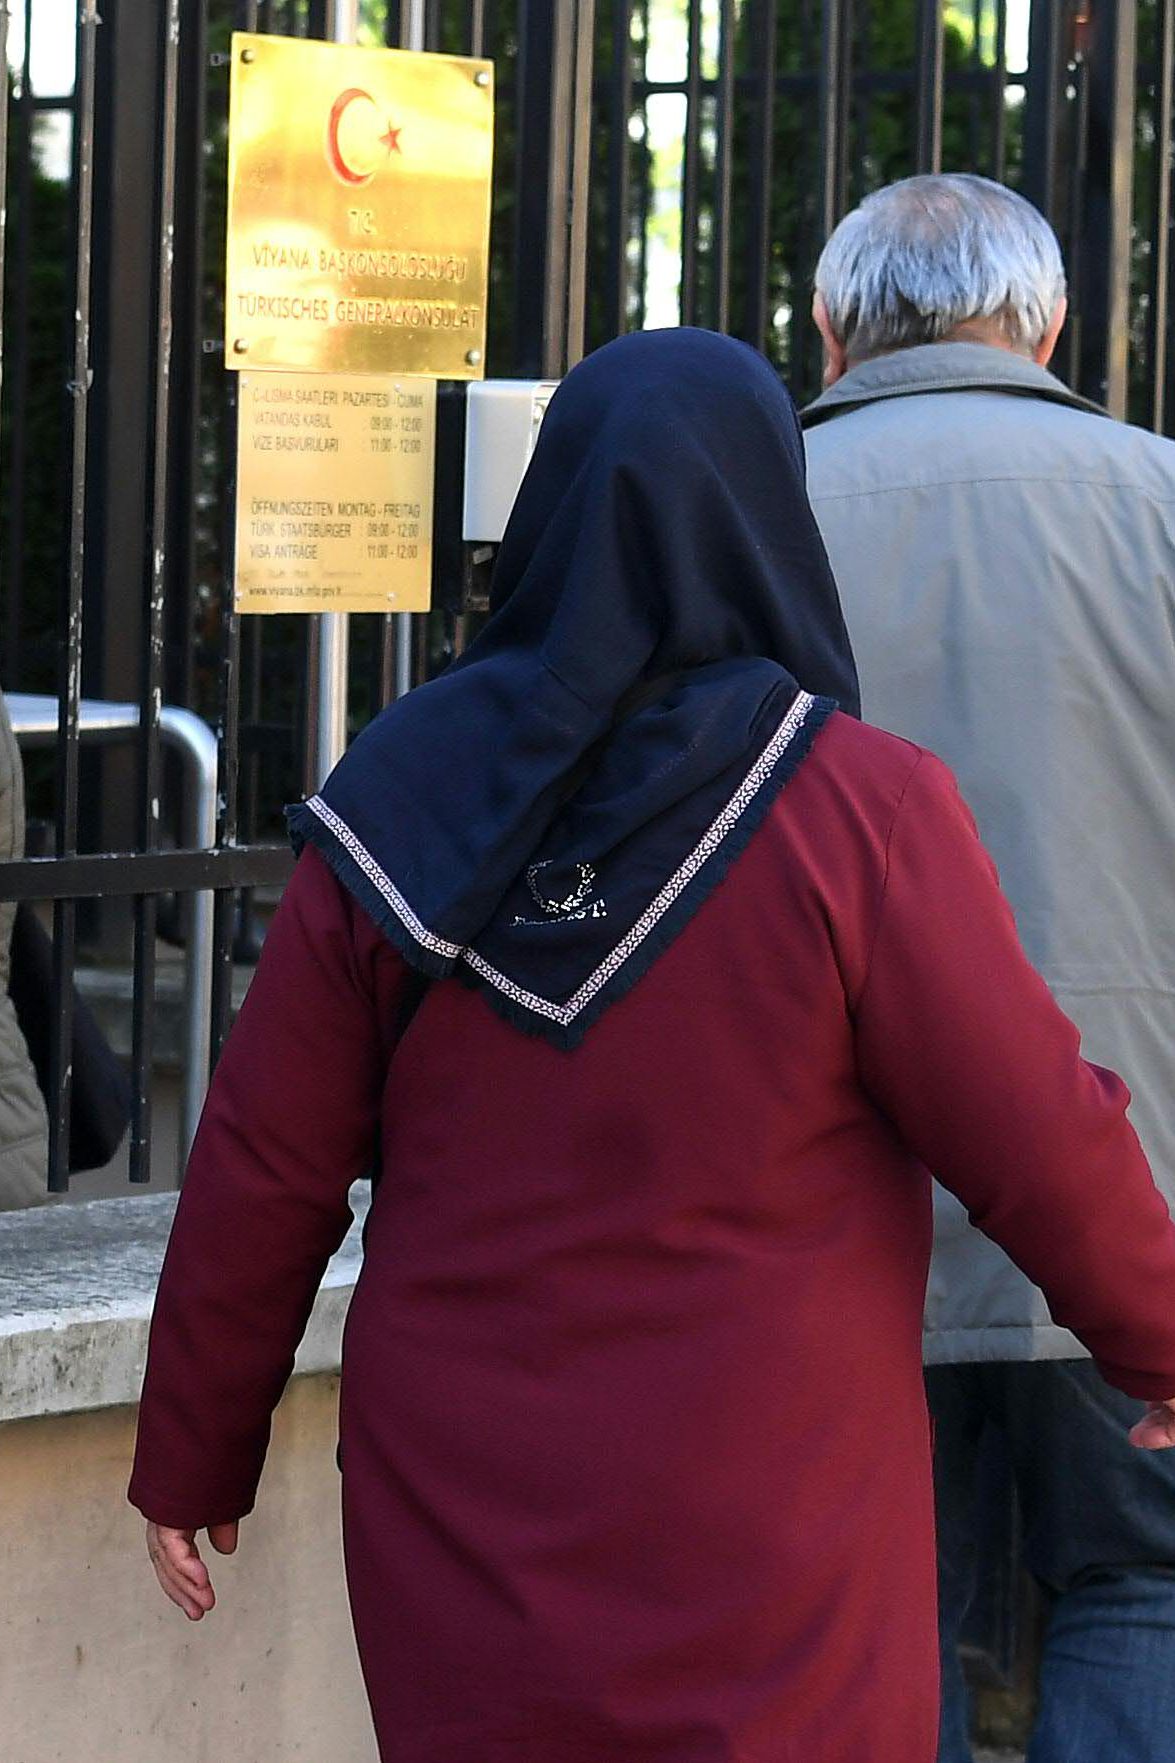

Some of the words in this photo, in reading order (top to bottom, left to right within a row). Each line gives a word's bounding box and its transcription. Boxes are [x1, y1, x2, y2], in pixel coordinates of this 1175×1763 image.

[335, 299, 481, 329] GENERALKONSULAT
[338, 502, 376, 518] MONTAG
[383, 503, 421, 519] FREITAG
